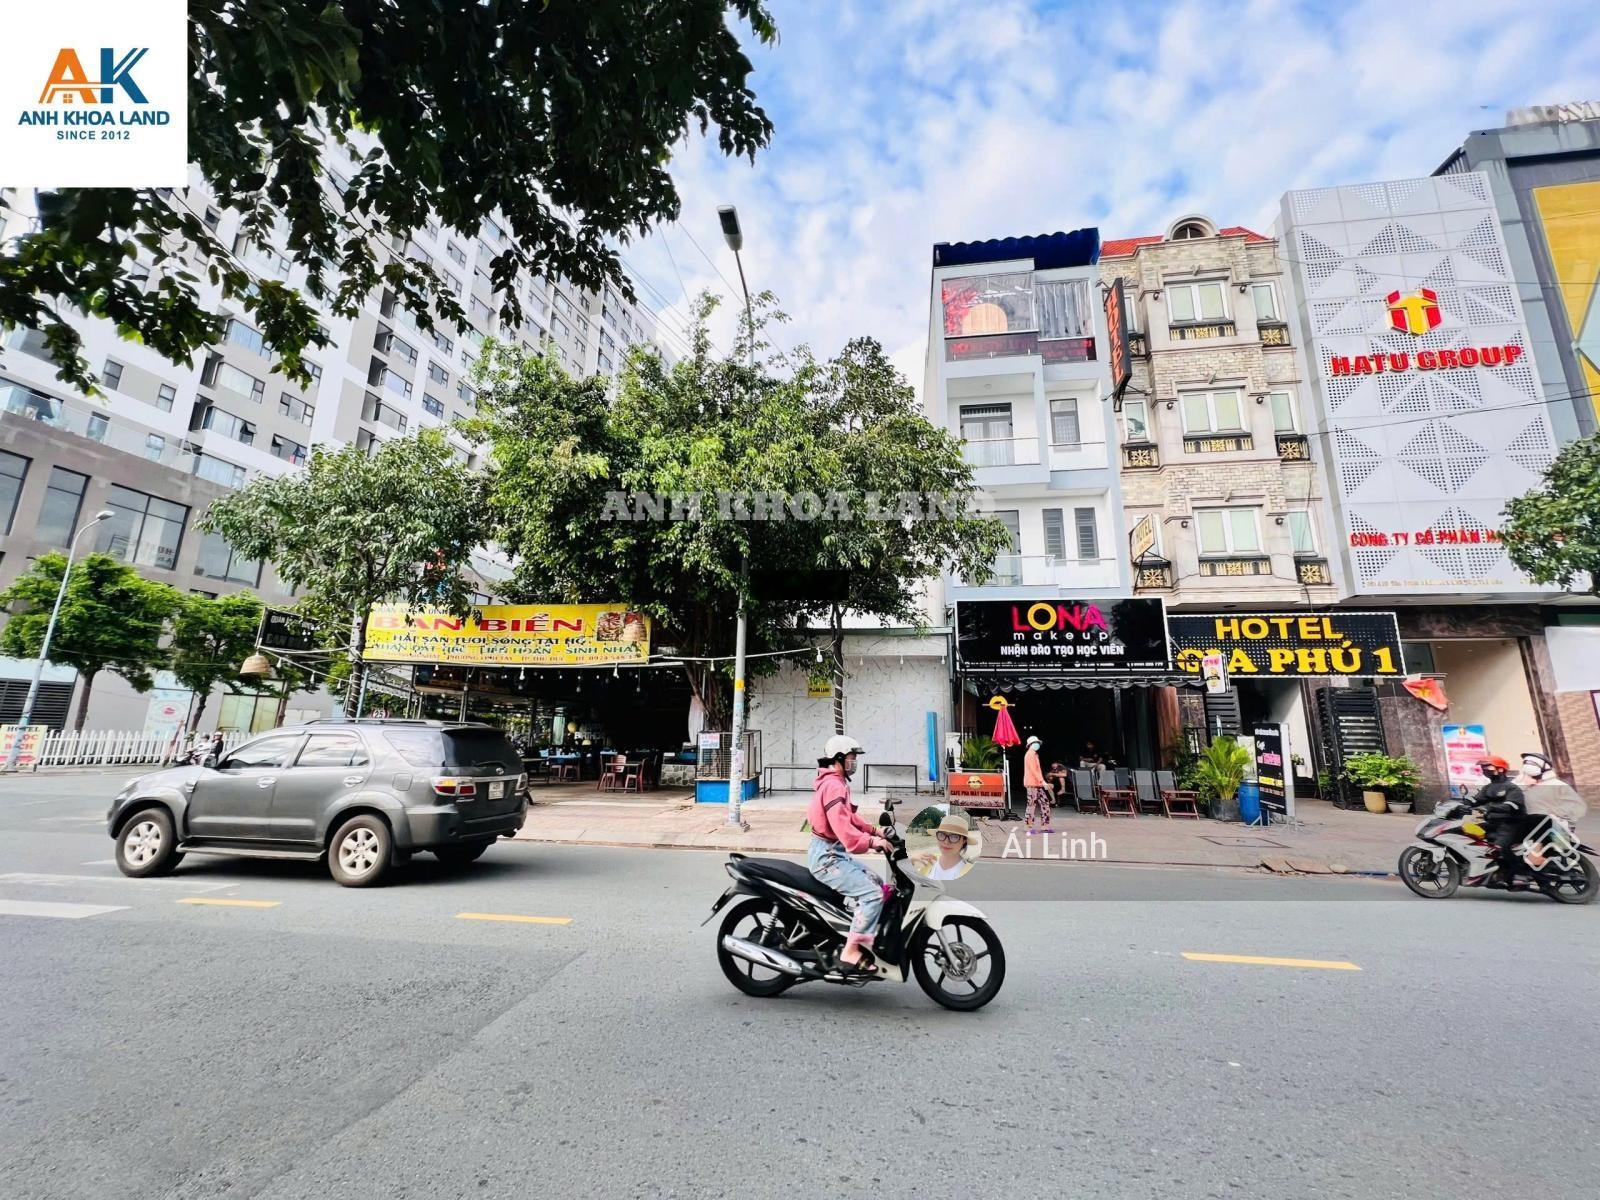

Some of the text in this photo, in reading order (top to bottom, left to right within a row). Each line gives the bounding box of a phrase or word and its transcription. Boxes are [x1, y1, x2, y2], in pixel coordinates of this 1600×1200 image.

[1330, 344, 1522, 377] HATU GROUP
[1392, 532, 1409, 546] TY
[479, 613, 583, 632] BIỂN
[1012, 603, 1109, 632] LONA
[1013, 630, 1109, 642] makeup
[1214, 618, 1344, 640] HOTEL
[566, 646, 598, 654] SINH
[1000, 643, 1028, 658] NHẬN
[1053, 645, 1075, 658] TẠO
[1076, 645, 1098, 658] HỌC
[1099, 643, 1125, 656] VIÊN
[1177, 640, 1398, 673] GA PHÚ 1
